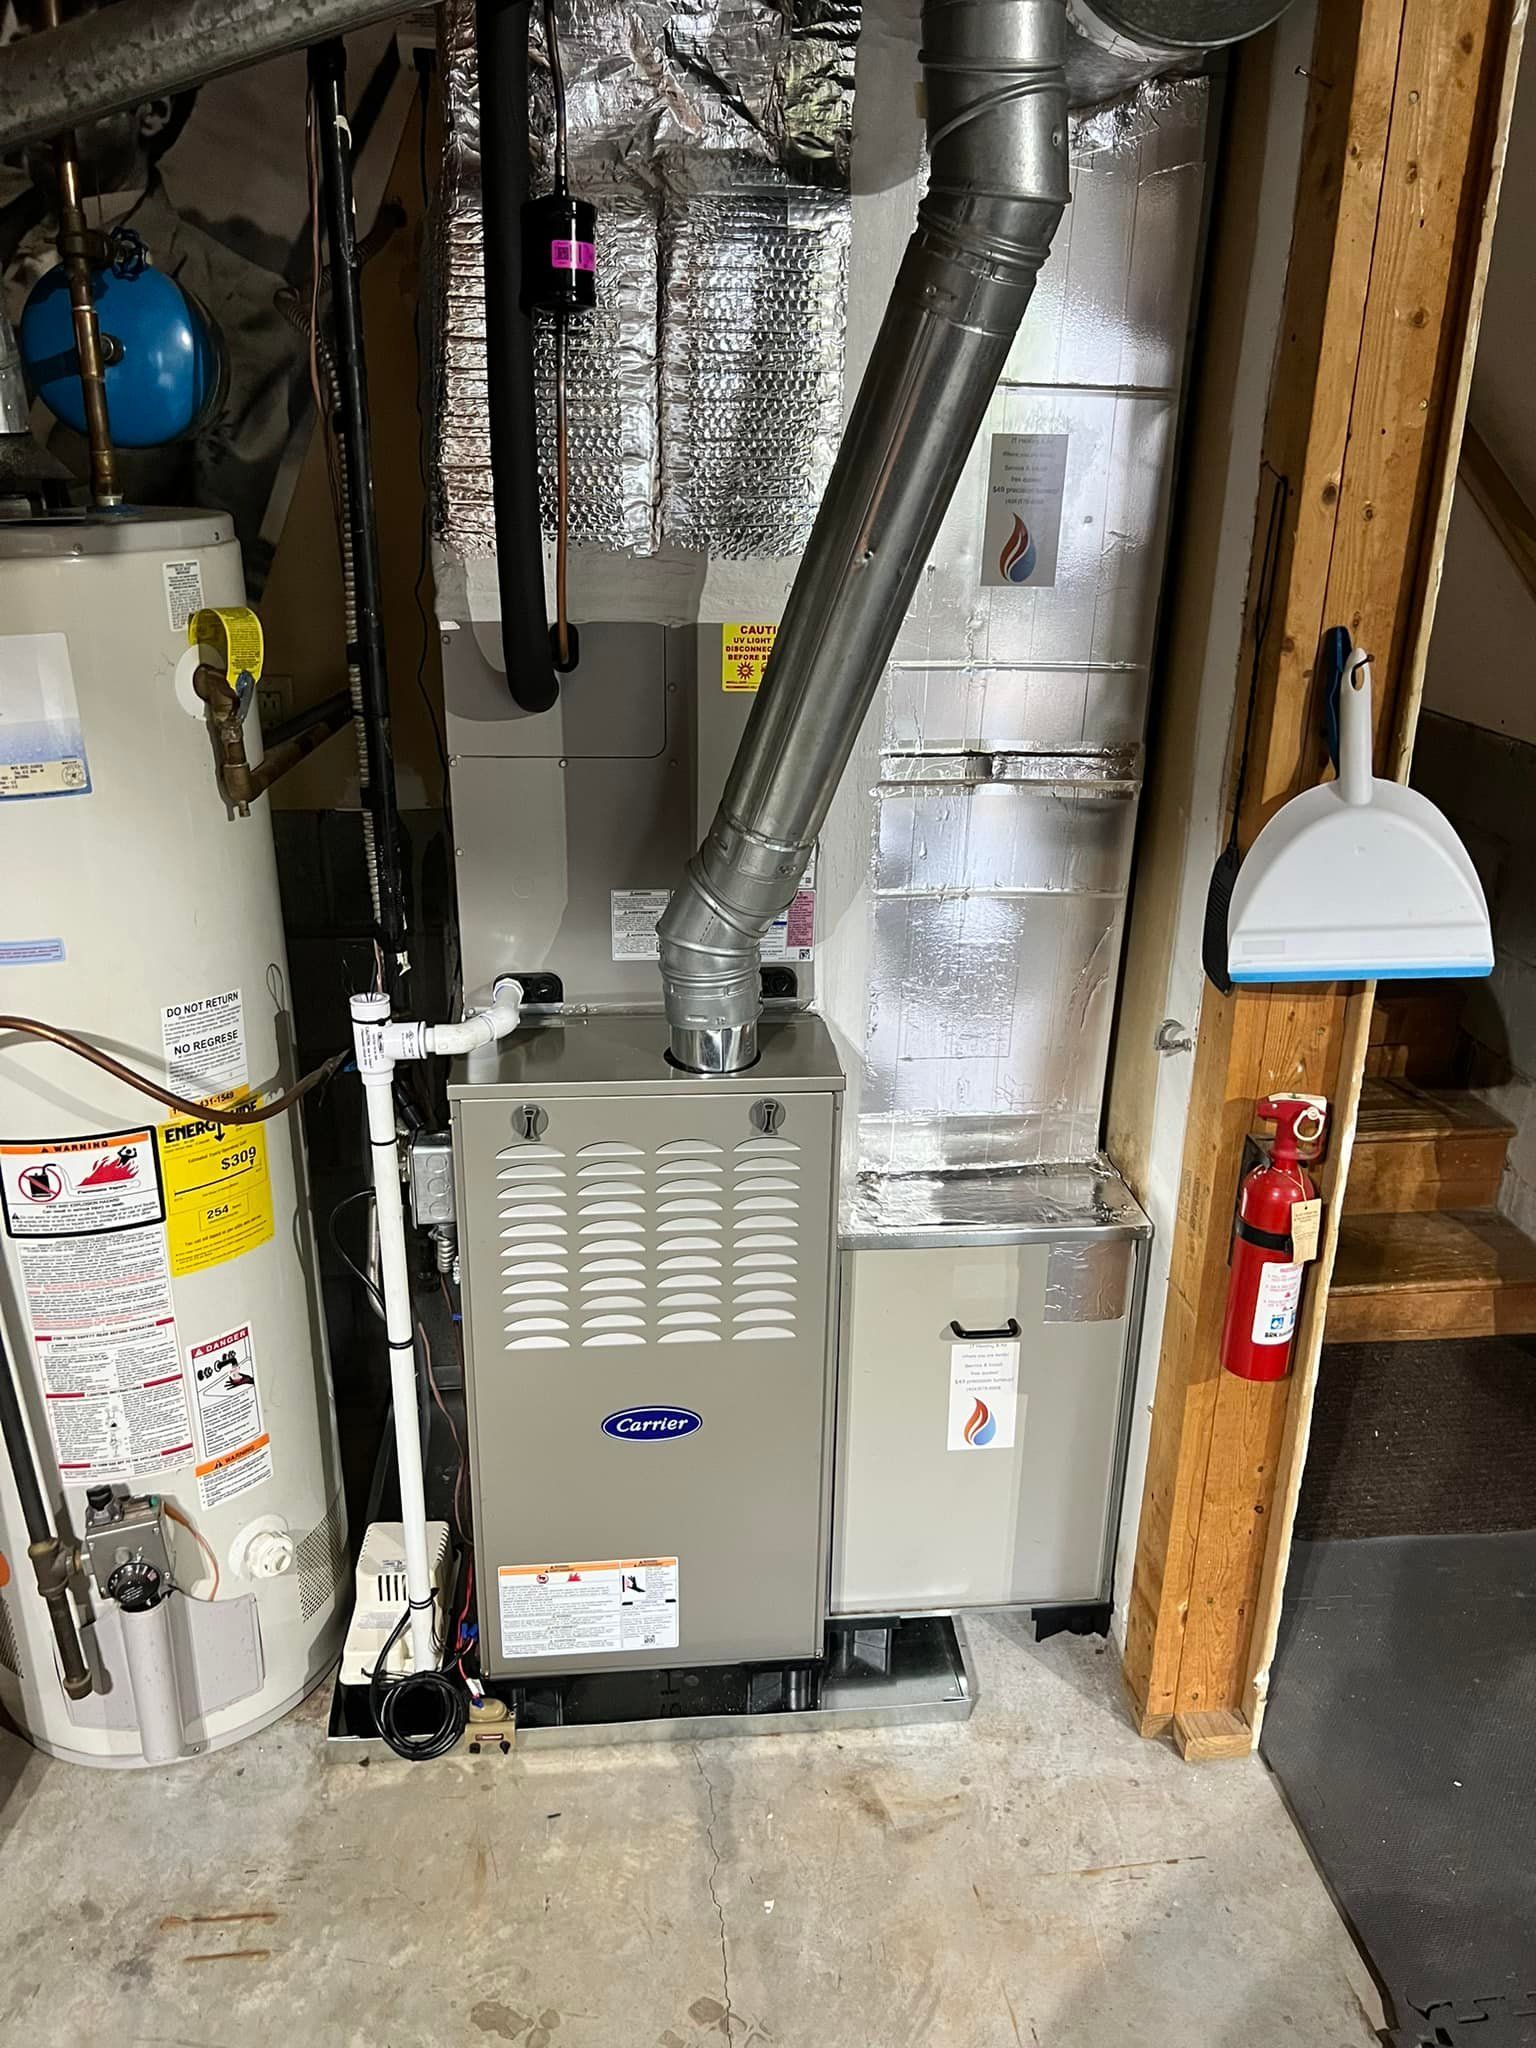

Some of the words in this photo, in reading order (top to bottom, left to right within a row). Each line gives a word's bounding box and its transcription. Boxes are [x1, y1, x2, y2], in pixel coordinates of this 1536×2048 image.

[740, 625, 777, 635] CAUTI
[166, 1006, 182, 1019] DO
[184, 1001, 204, 1015] NOT
[205, 991, 239, 1009] RETURN
[174, 1043, 191, 1056] NO
[193, 1029, 239, 1051] REGRESE
[53, 1140, 109, 1153] WARNING
[221, 1146, 257, 1171] $309
[206, 1203, 229, 1220] 254
[206, 1329, 246, 1353] DANGER
[616, 1417, 689, 1433] Carrier
[225, 1444, 255, 1464] WARNING
